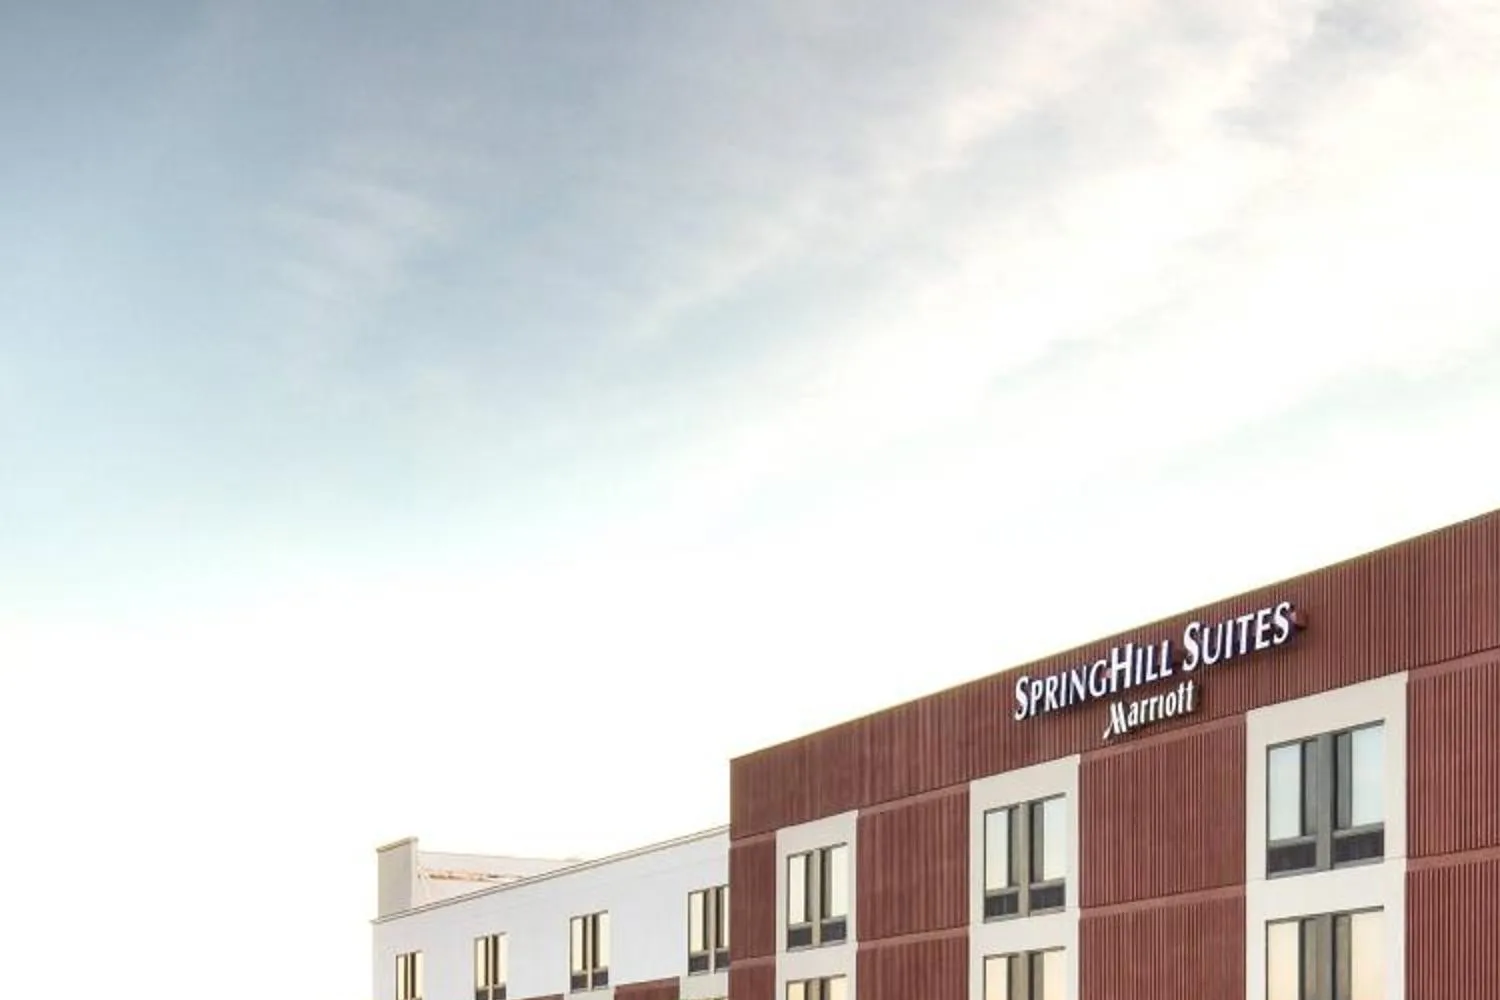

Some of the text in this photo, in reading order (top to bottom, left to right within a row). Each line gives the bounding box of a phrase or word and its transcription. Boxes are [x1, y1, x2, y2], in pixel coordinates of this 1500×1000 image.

[1014, 601, 1291, 720] SPRINGHILL SUITES
[1103, 680, 1195, 739] Marriott
